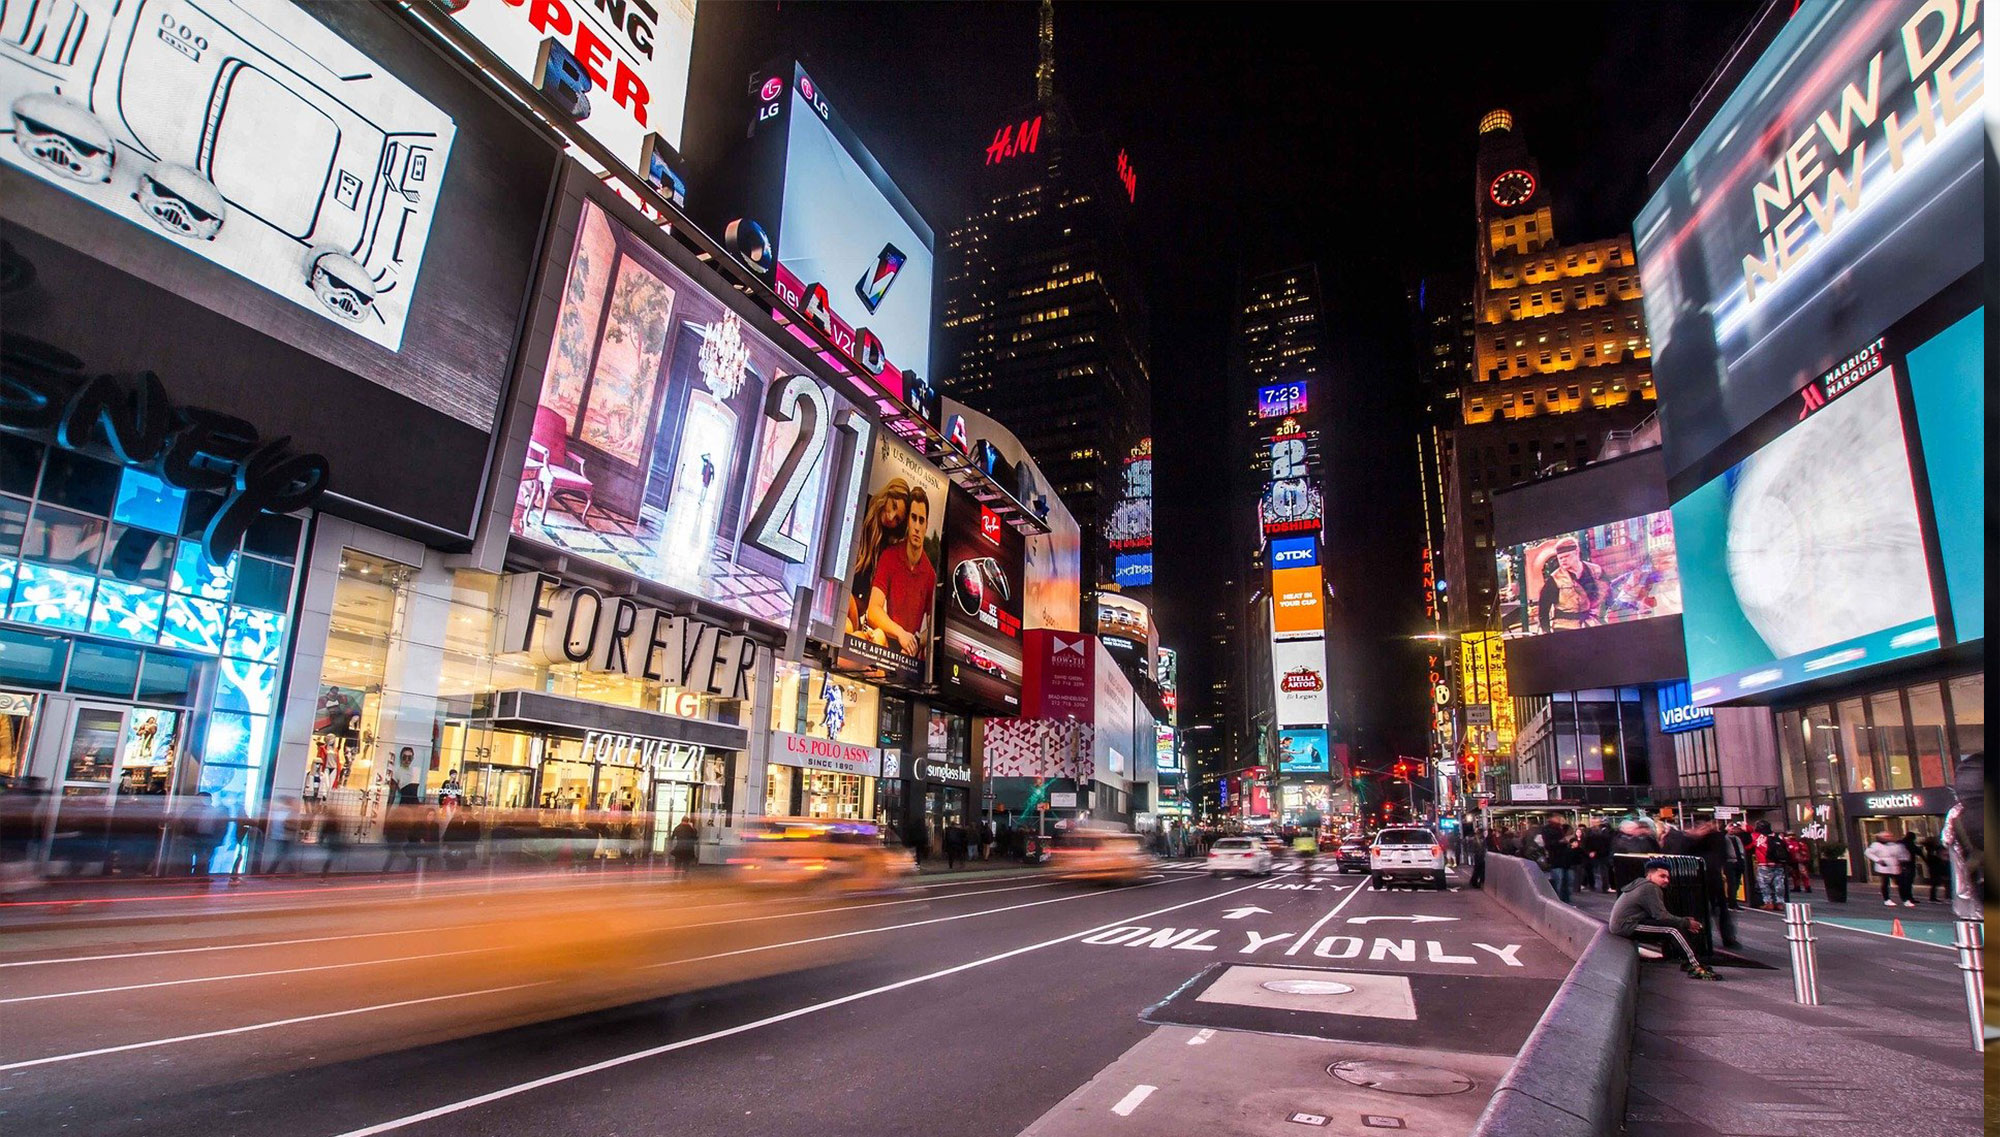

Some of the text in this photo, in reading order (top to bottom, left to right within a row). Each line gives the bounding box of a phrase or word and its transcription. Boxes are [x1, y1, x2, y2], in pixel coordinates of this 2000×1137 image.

[509, 0, 650, 130] PER
[760, 102, 779, 121] LG
[813, 92, 829, 120] LG
[986, 115, 1042, 166] H&M
[1752, 50, 1882, 234] NEW
[1741, 140, 1866, 304] NEW
[1825, 337, 1885, 385] MARRIOTT
[1826, 356, 1880, 398] MARQUIS
[1265, 386, 1300, 404] 7:23
[1276, 424, 1301, 436] 2017
[748, 374, 872, 582] 21
[906, 457, 923, 477] POLO
[1263, 517, 1322, 533] TOSHIBA
[1284, 549, 1312, 560] TDK
[1422, 548, 1434, 618] ERNST
[520, 572, 757, 700] FOREVER
[850, 638, 867, 650] LIVE
[870, 646, 918, 667] AUTHENTICALLY
[675, 692, 698, 718] G
[580, 731, 705, 774] FOREVER 21
[787, 736, 872, 763] U.S. POLO ASSN.
[808, 758, 854, 771] SINCE 1890
[927, 763, 971, 783] sunglass hut
[1868, 794, 1913, 809] swatch
[1257, 884, 1353, 892] ONLY
[1081, 926, 1525, 967] ONLY ONLY
